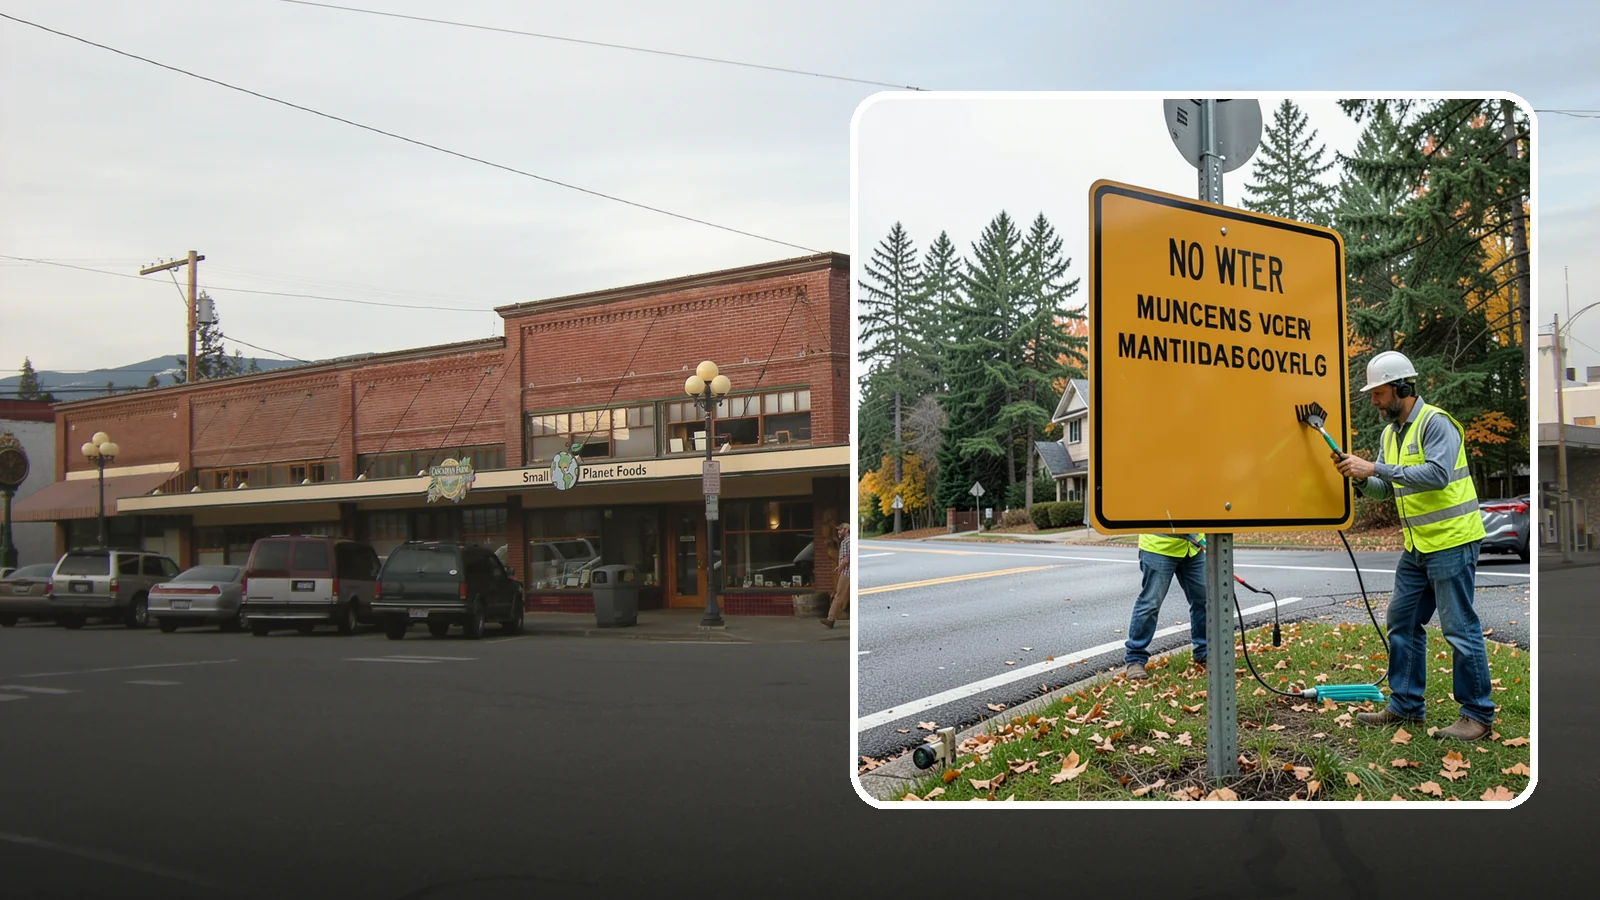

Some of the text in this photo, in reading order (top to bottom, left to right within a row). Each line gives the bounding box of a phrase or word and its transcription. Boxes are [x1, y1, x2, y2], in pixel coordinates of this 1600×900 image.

[1169, 238, 1284, 294] NO WTER
[1137, 294, 1251, 333] MUNCENS
[523, 464, 647, 483] Small Planet Foods
